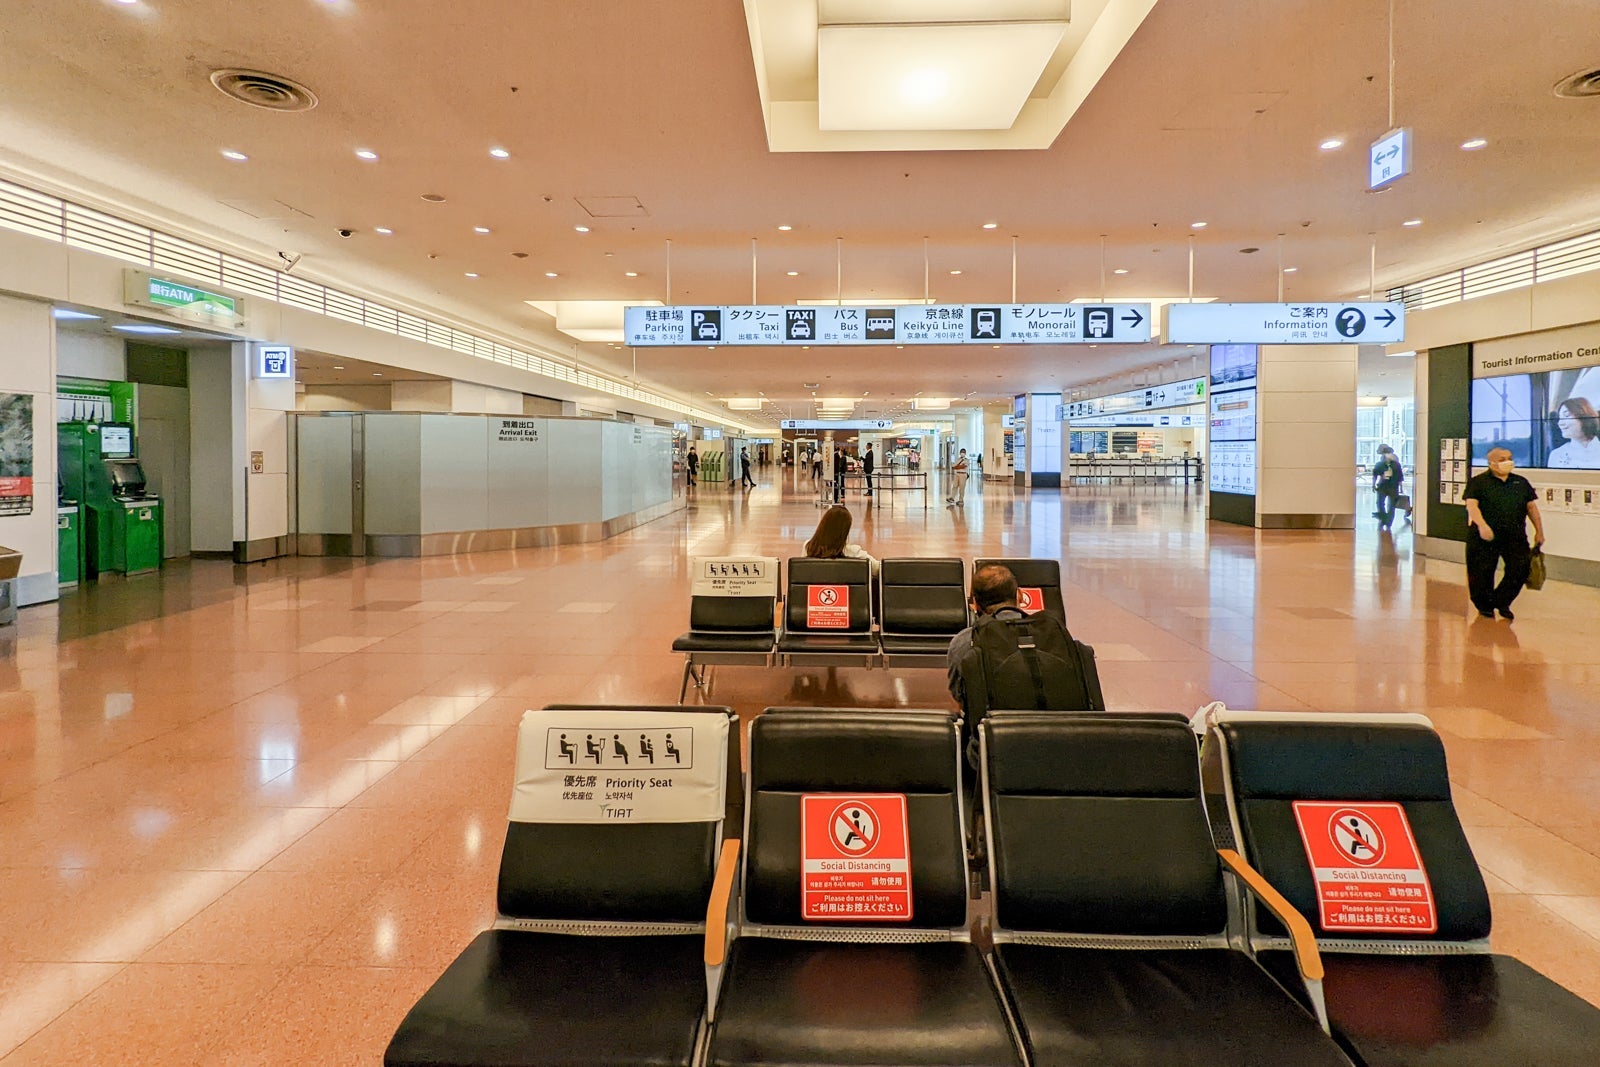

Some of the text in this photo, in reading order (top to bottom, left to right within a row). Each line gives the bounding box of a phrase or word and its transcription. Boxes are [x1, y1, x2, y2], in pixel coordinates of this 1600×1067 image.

[646, 310, 683, 321] 駐車場
[730, 310, 779, 320] タクシー
[788, 311, 814, 320] TAXI
[834, 310, 858, 320] バス
[925, 308, 964, 320] 京急線
[1012, 308, 1076, 318] モノレール
[1290, 307, 1328, 318] ご案内
[646, 323, 684, 333] Parking
[760, 323, 779, 331] Taxi
[904, 322, 964, 332] Keikyū Line
[1028, 321, 1076, 329] Monorail
[1264, 320, 1328, 329] Information
[1482, 358, 1512, 369] Tourist
[1515, 350, 1572, 365] Information
[564, 775, 672, 790] 優先席 Priority Seat
[562, 792, 633, 800] 优先座位 노약자석
[606, 808, 633, 818] TIAT
[821, 862, 891, 871] Social Distancing
[1332, 870, 1406, 882] Social Distancing
[812, 903, 903, 912] ご利用はお控えください
[1330, 913, 1426, 924] ご利用はお控えください
